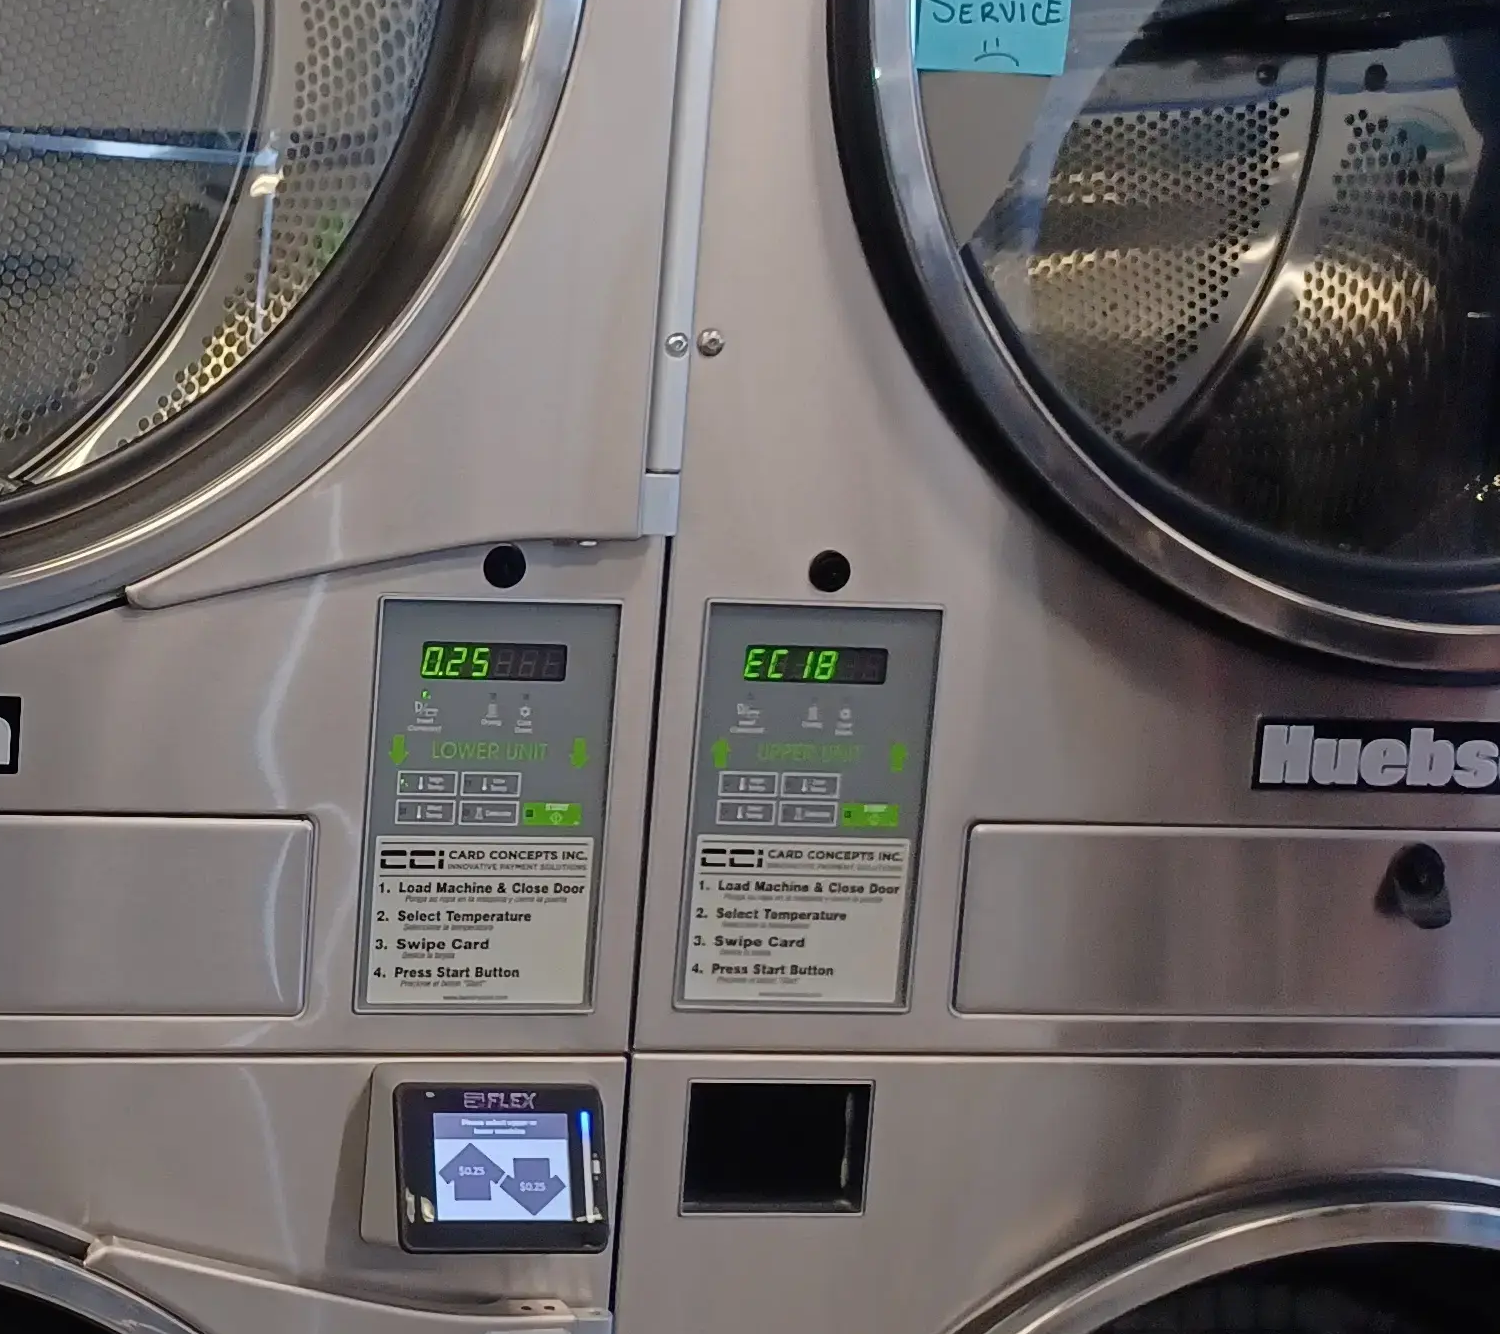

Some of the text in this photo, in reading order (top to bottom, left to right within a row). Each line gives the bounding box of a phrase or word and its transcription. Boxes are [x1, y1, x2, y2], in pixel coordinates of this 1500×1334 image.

[421, 647, 490, 677] 0.25
[432, 741, 547, 761] LOWER UNIT
[1259, 725, 1500, 788] Huebs
[449, 850, 588, 860] CARD CONCEPTS INC.
[768, 850, 903, 862] CARD CONCEPTS INC.
[379, 882, 585, 894] 1. Load Machine & Close Door
[718, 880, 750, 891] Load
[755, 881, 809, 892] Machine
[814, 882, 823, 893] &
[829, 882, 864, 893] Close
[870, 883, 900, 894] Door
[377, 911, 531, 923] 2. Select Temperature
[696, 908, 847, 921] 2. Select Temperature
[375, 939, 489, 952] 3. Swipe Card
[693, 936, 805, 948] 3. Swipe Card
[374, 967, 520, 978] 4. Press Start Button
[692, 964, 834, 976] 4. Press Start Button
